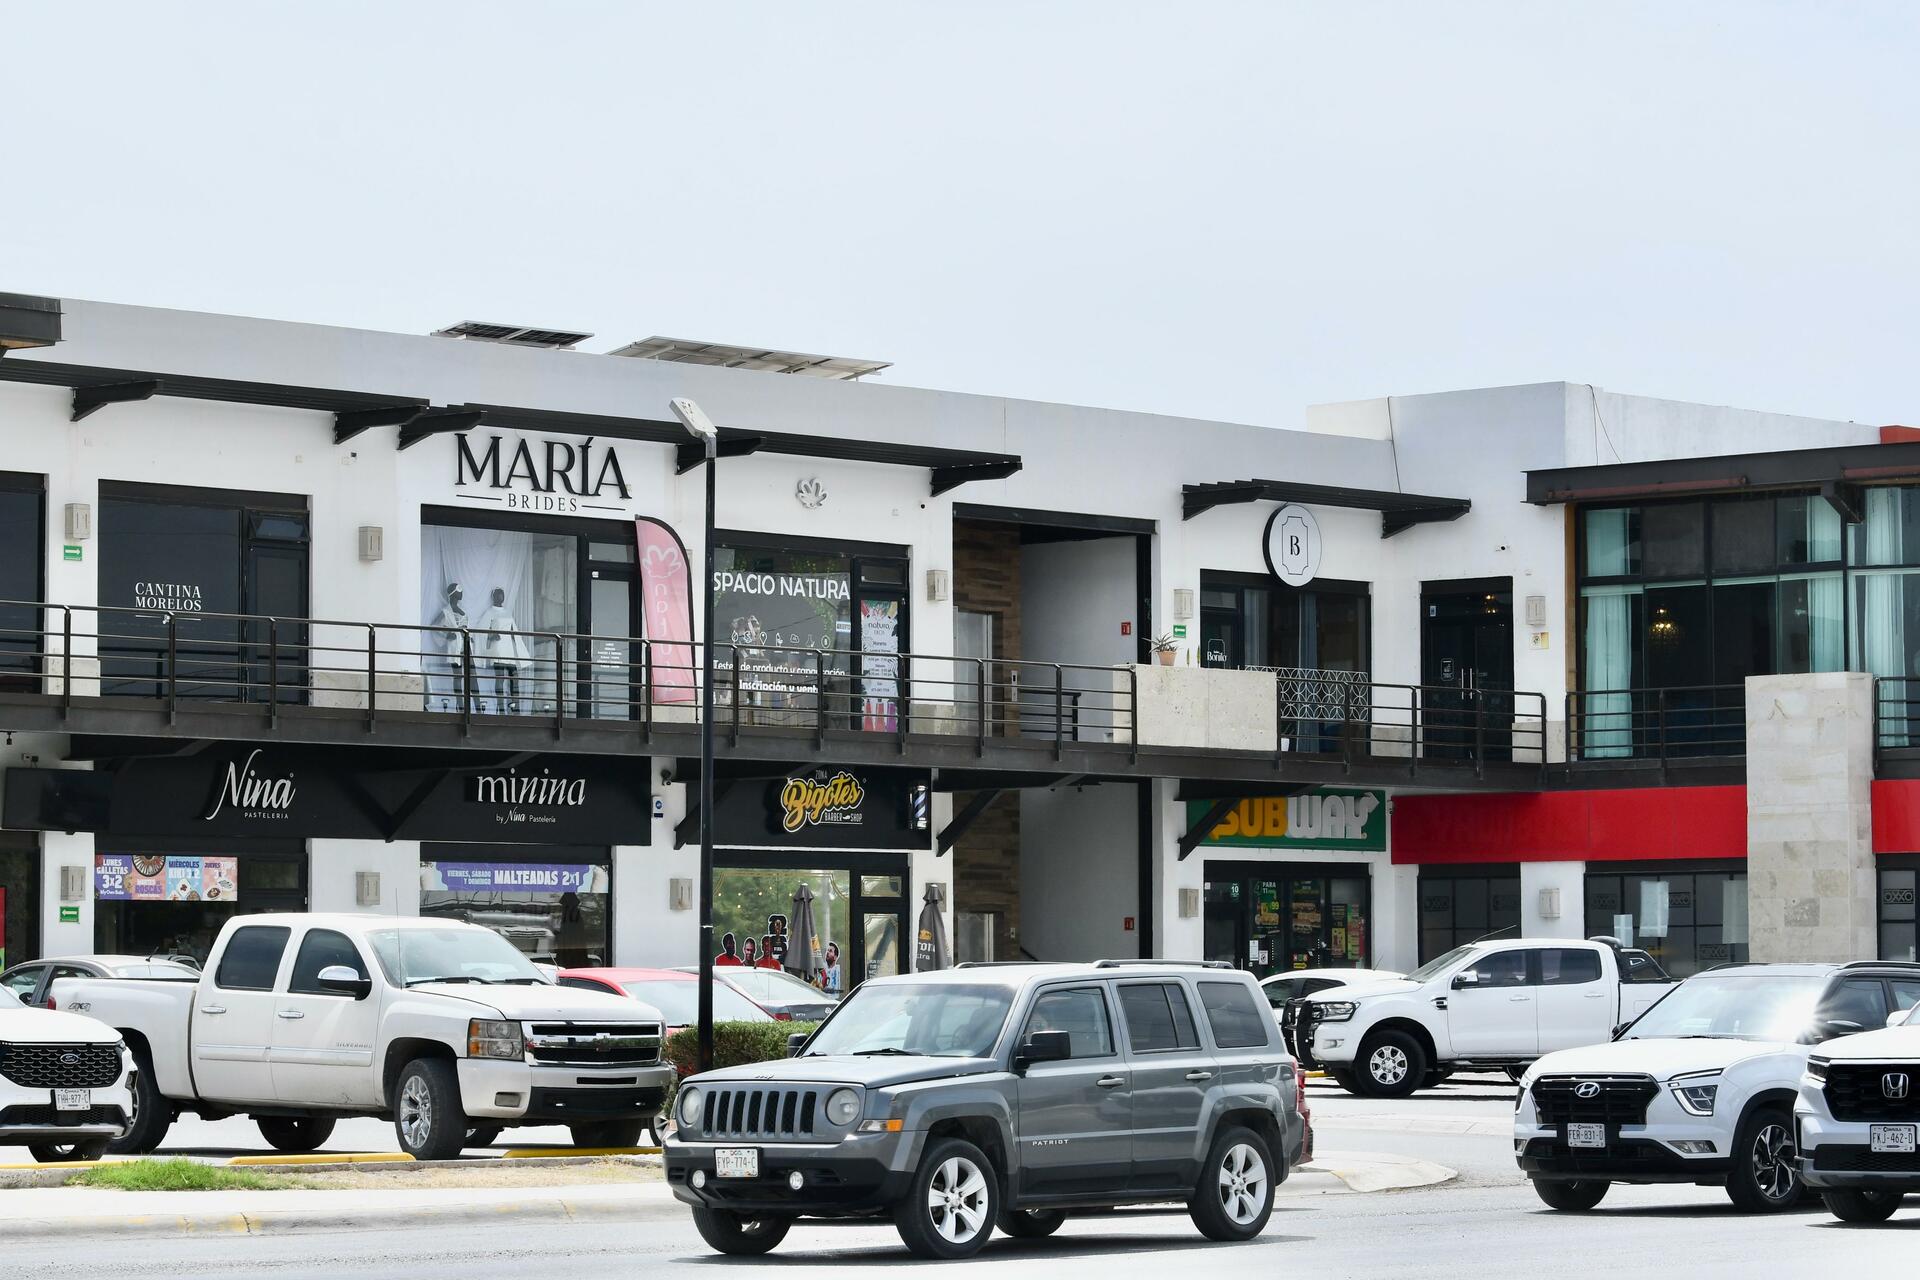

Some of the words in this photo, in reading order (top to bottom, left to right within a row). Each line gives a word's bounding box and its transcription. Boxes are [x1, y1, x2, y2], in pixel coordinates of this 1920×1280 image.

[455, 433, 632, 499] MARÍA
[508, 494, 577, 512] BRIDES
[1290, 535, 1301, 556] B
[135, 582, 201, 598] CANTINA
[713, 572, 776, 595] SPACIO
[780, 576, 850, 600] NATURA
[135, 597, 202, 611] MORELOS
[205, 749, 296, 820] Nina
[477, 768, 586, 805] minina
[782, 774, 862, 829] Bigotes
[244, 812, 289, 820] PASTELERIA
[496, 814, 504, 823] by
[503, 807, 526, 825] Nina
[825, 812, 842, 822] BARBER
[851, 813, 863, 822] SHOP
[96, 867, 129, 875] GALLETAS
[102, 859, 122, 867] LUNES
[494, 870, 558, 886] MALTEADAS
[1884, 890, 1913, 903] OXXO
